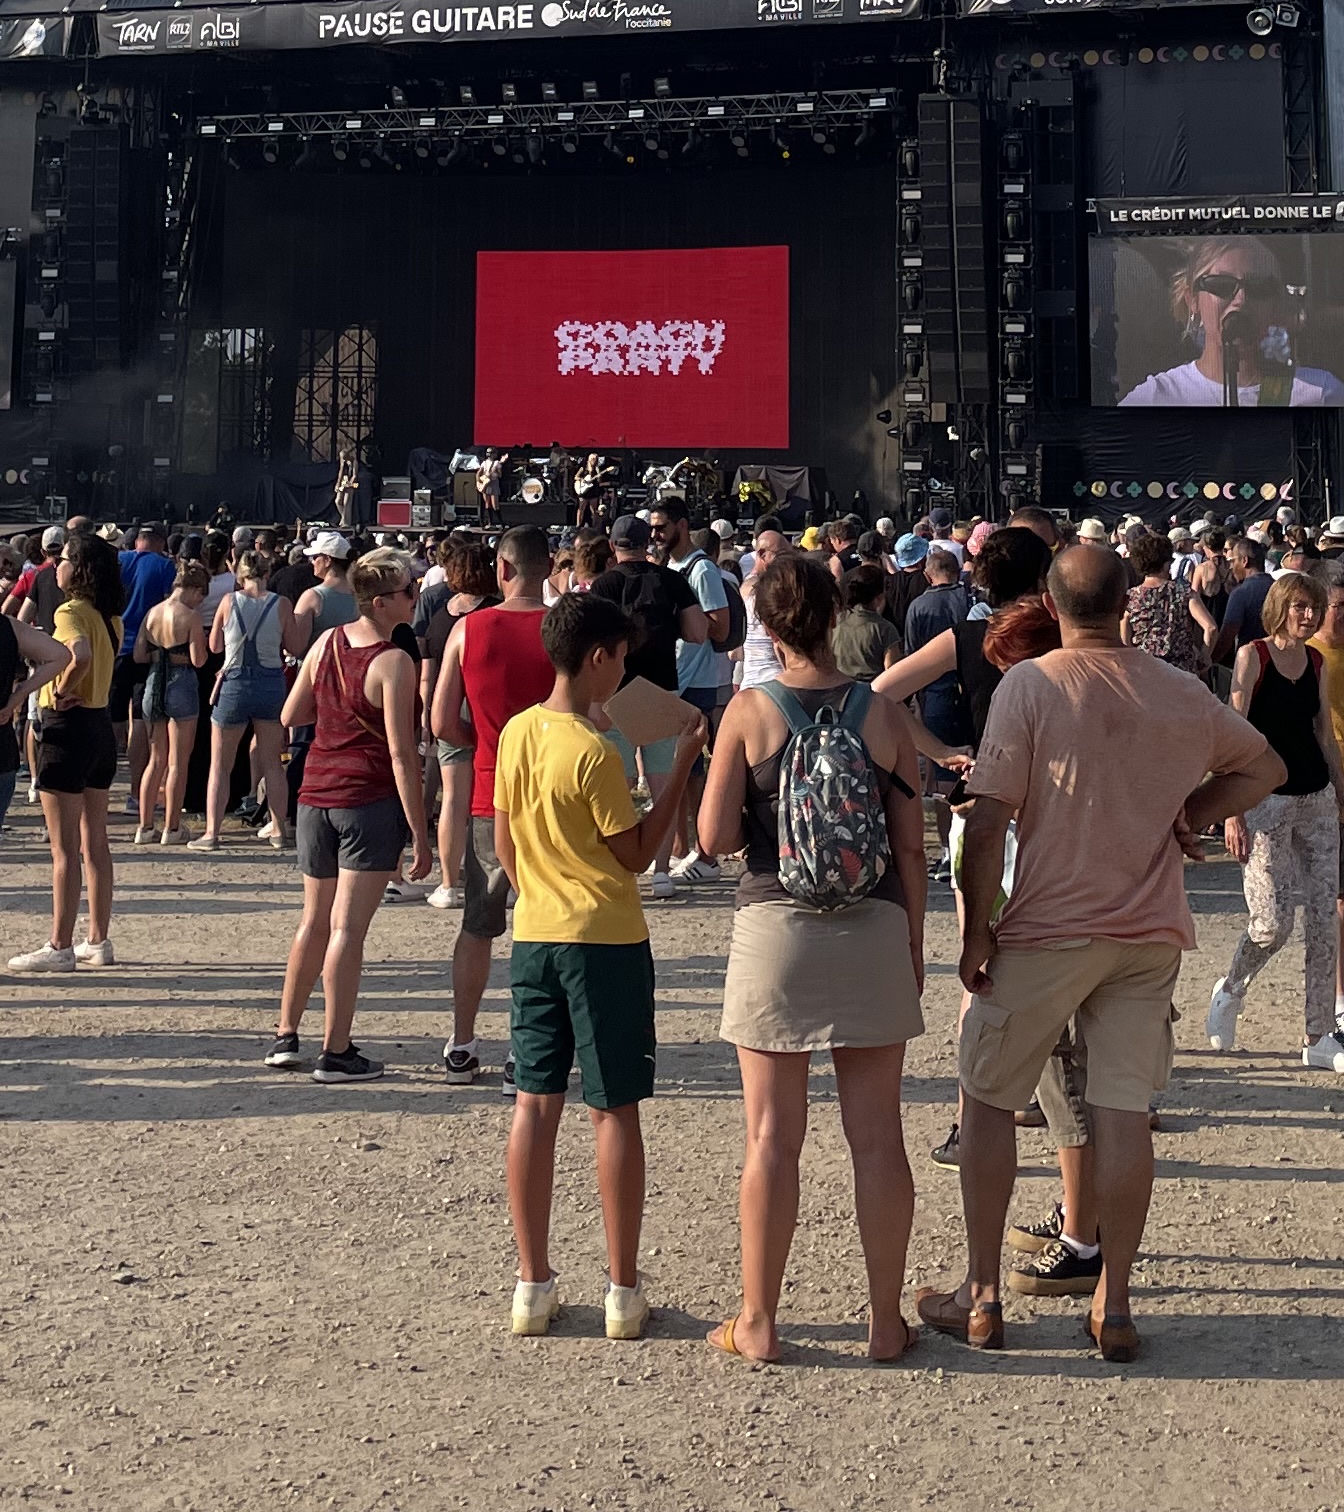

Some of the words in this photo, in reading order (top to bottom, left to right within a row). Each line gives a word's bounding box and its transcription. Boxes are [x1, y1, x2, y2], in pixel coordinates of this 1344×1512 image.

[319, 11, 405, 38] PAUSE
[411, 4, 534, 33] GUITARE
[557, 0, 591, 21] Sud
[589, 2, 612, 18] de
[112, 18, 161, 45] TARN
[169, 22, 191, 35] RTL2
[1110, 209, 1128, 222] LE
[1131, 206, 1185, 221] CRÉDIT
[1189, 207, 1250, 220] MUTUEL
[1254, 205, 1309, 219] DONNE
[1312, 205, 1332, 218] LE
[554, 319, 726, 350] COACH
[558, 343, 723, 376] PARTY
